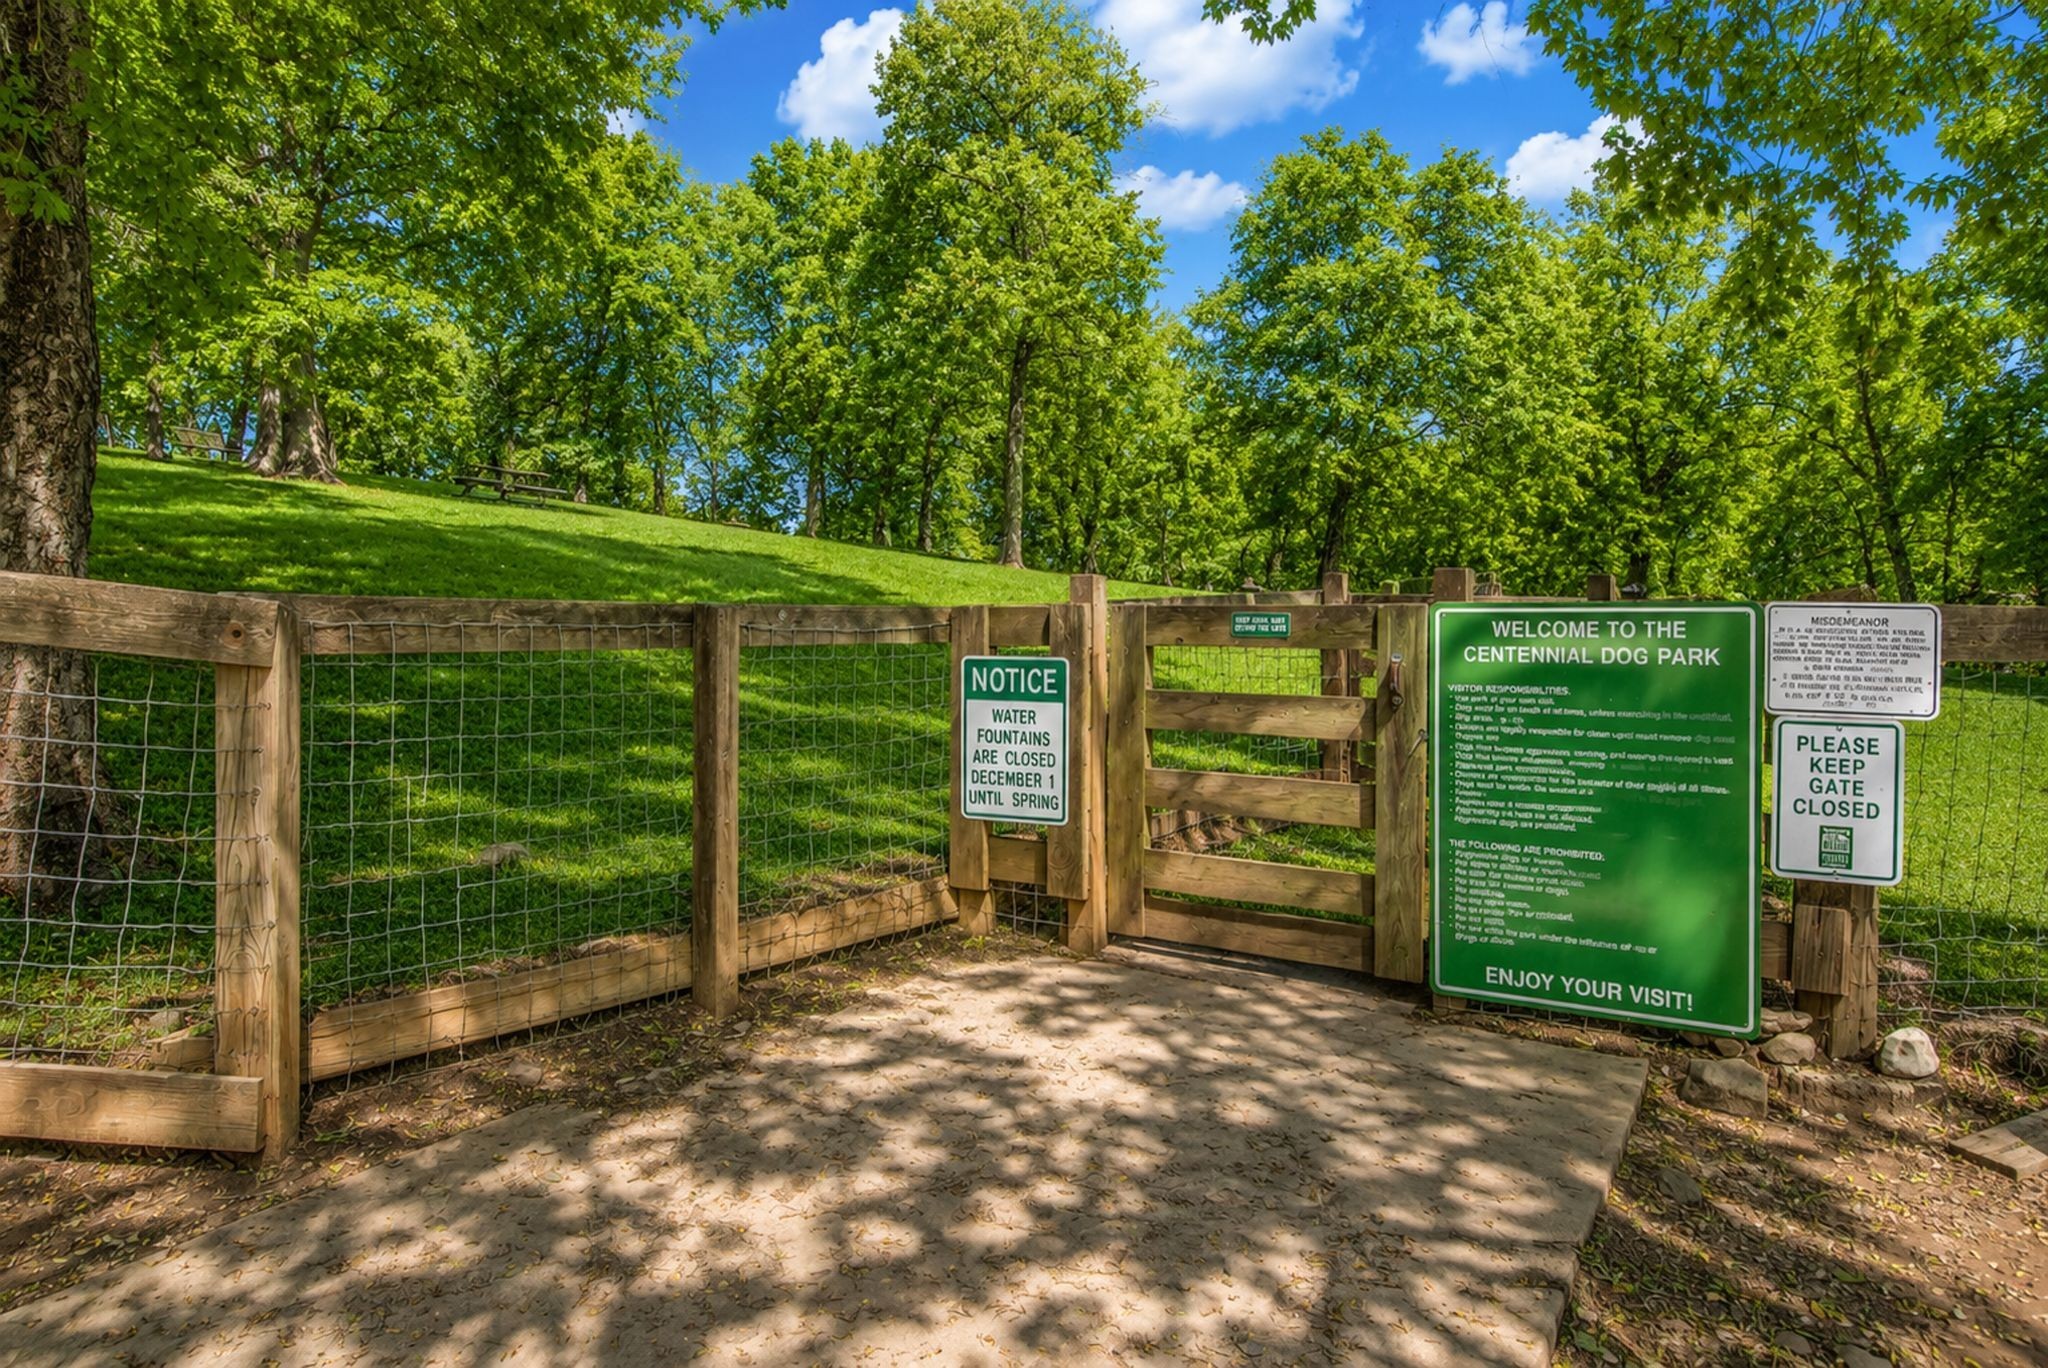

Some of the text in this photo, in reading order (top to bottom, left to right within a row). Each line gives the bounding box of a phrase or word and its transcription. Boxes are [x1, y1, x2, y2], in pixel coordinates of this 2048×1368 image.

[1492, 621, 1687, 639] WELCOME TO THE
[1463, 646, 1721, 666] CENTENNIAL DOG PARK
[971, 667, 1058, 694] NOTICE
[1447, 684, 1483, 693] VISITOR
[992, 708, 1036, 725] WATER
[977, 728, 1050, 747] FOUNTAINS
[1797, 735, 1880, 755] PLEASE
[972, 749, 1056, 768] ARE CLOSED
[1810, 757, 1865, 775] KEEP
[971, 769, 1055, 789] DECEMBER 1
[1809, 777, 1864, 797] GATE
[968, 790, 1059, 810] UNTIL SPRING
[1793, 797, 1880, 819] CLOSED
[1449, 838, 1466, 848] THE
[1468, 840, 1521, 853] FOLLOWING
[1523, 845, 1541, 855] ARE
[1485, 965, 1693, 1012] ENJOY YOUR VISIT!
